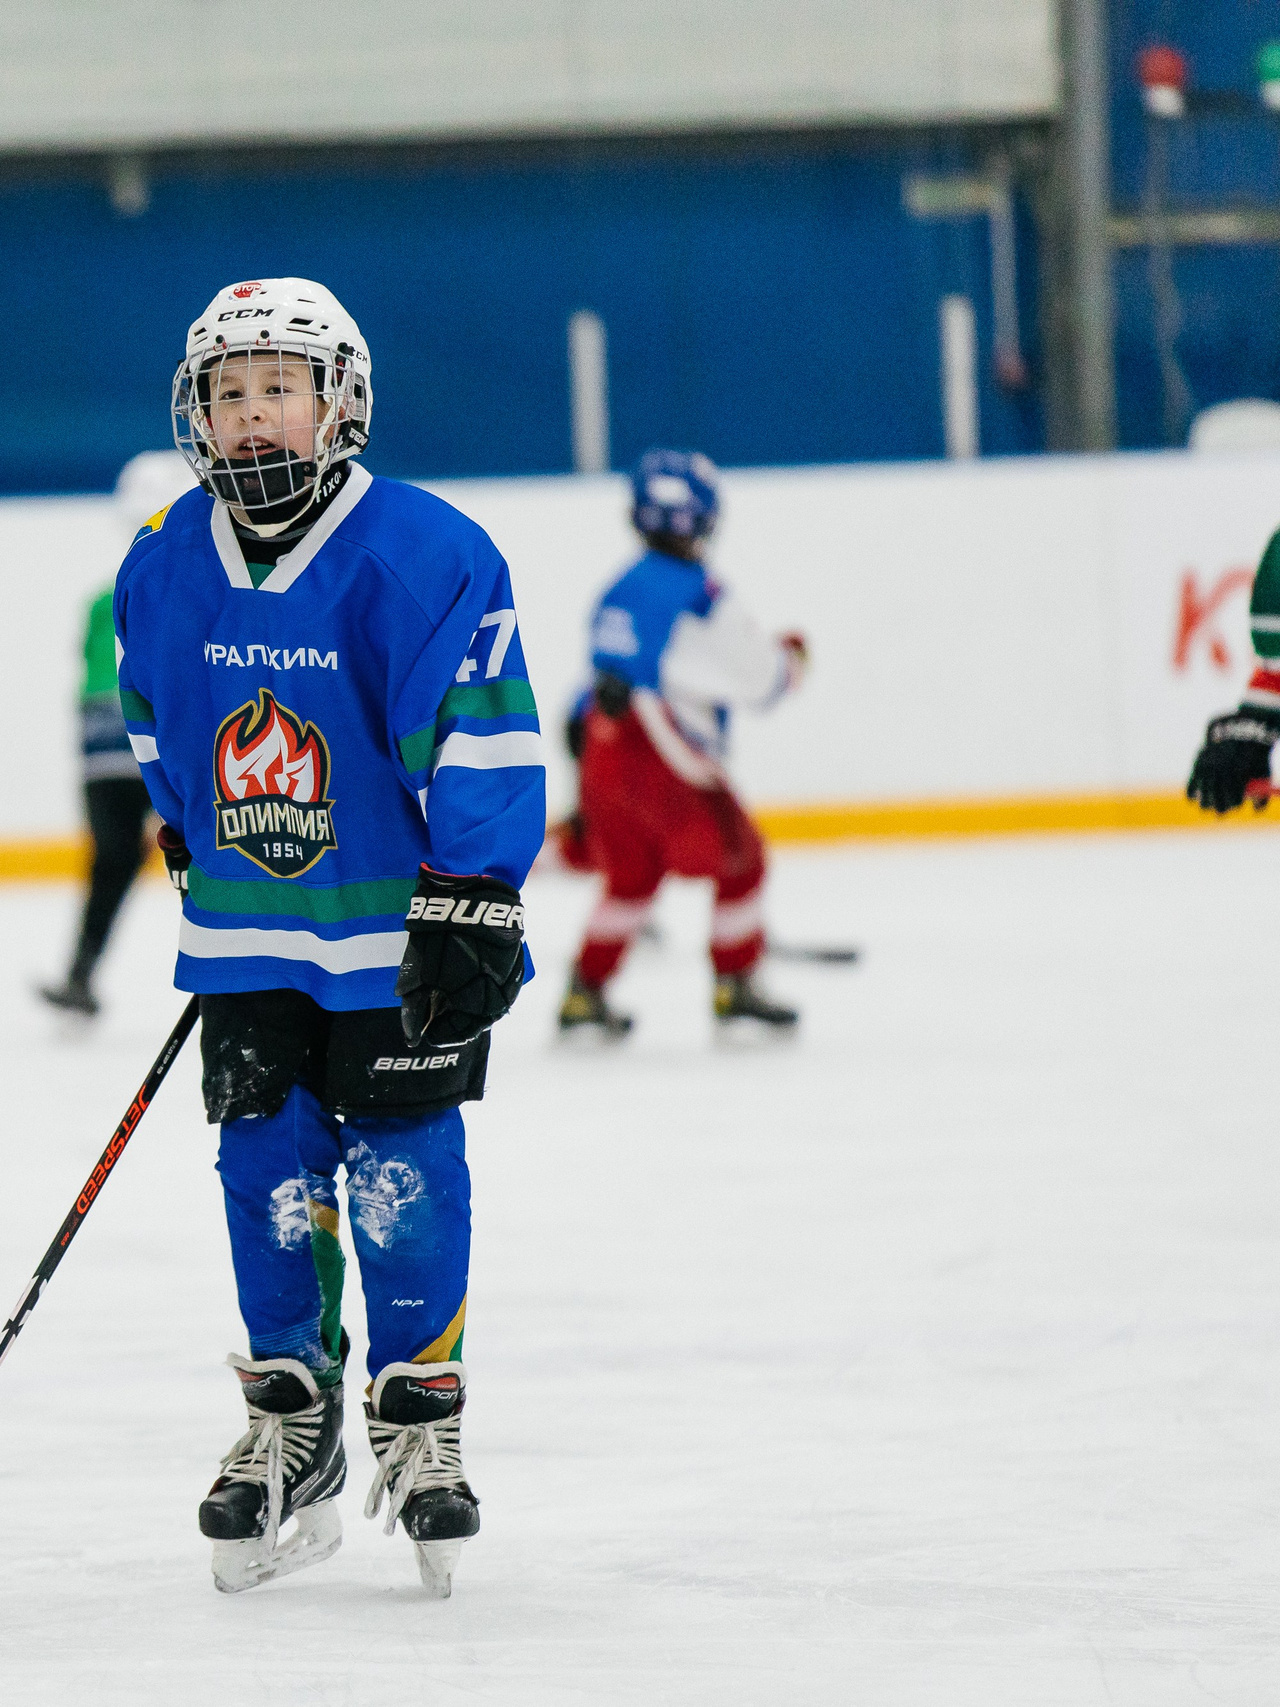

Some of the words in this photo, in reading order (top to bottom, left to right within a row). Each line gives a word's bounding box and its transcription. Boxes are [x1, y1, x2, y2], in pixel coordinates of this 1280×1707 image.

[218, 309, 274, 322] CCM
[221, 802, 330, 840] ОЛИМПИЯ
[263, 842, 303, 860] 1954
[406, 896, 524, 930] BAUER
[373, 1053, 459, 1070] BAUER
[76, 1085, 150, 1214] JETSPEED
[392, 1299, 424, 1307] NPP
